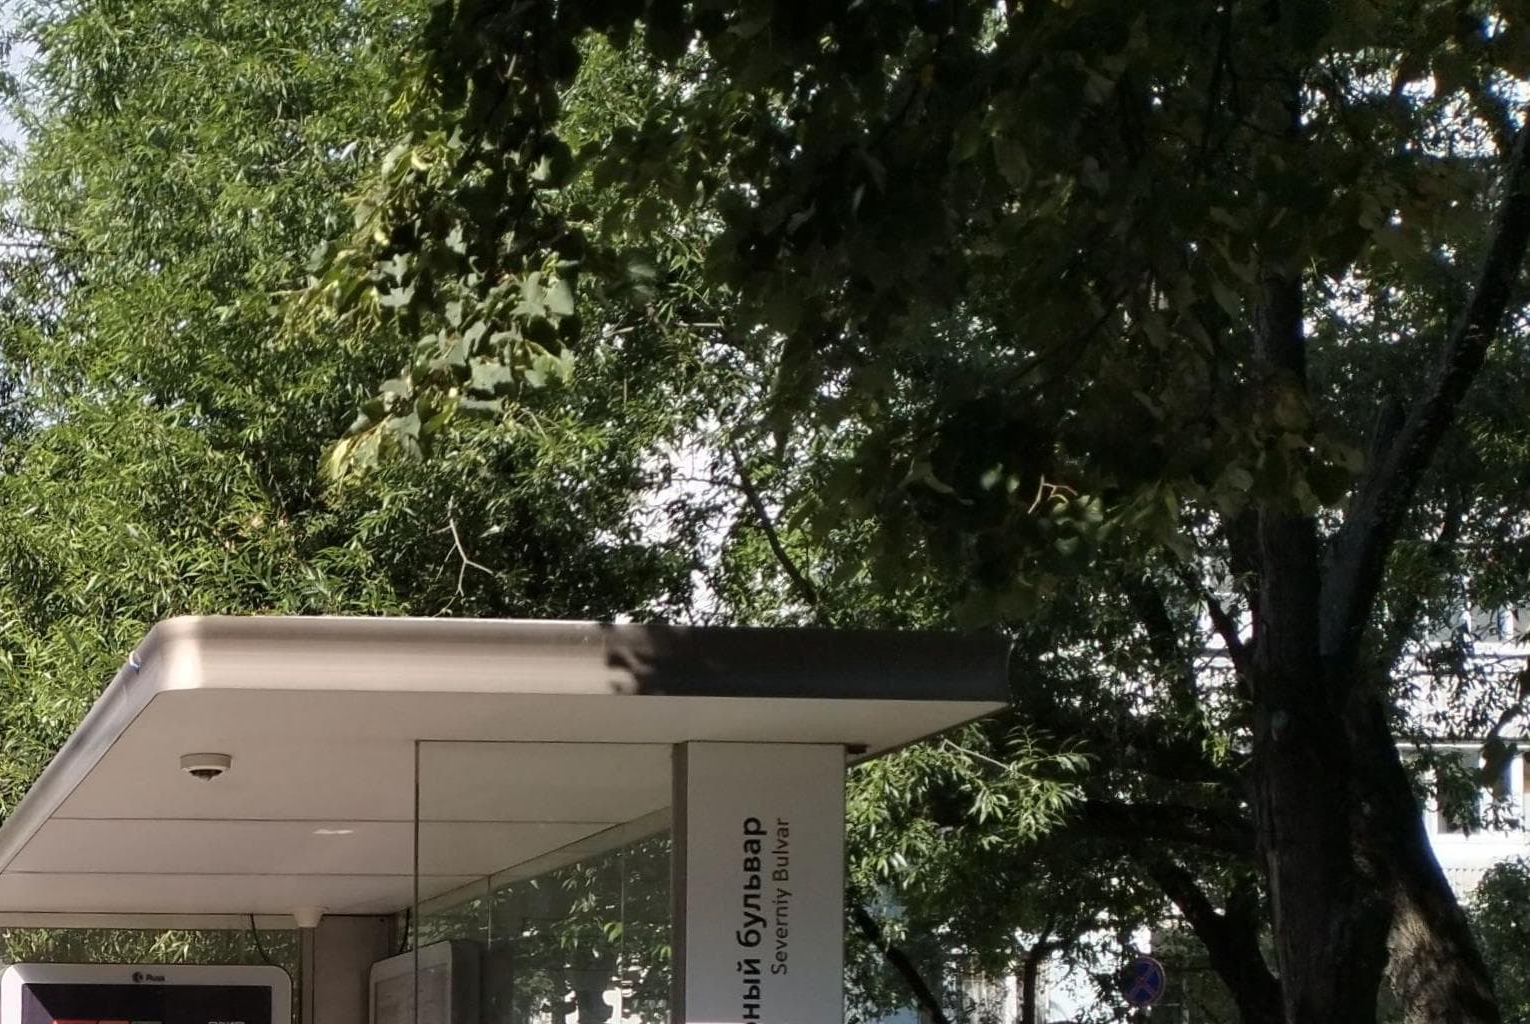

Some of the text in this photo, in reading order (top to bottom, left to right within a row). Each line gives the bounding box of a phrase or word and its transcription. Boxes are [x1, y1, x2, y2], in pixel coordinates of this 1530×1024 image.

[736, 816, 767, 948] бульвар
[771, 817, 792, 976] Severniy Bulvar
